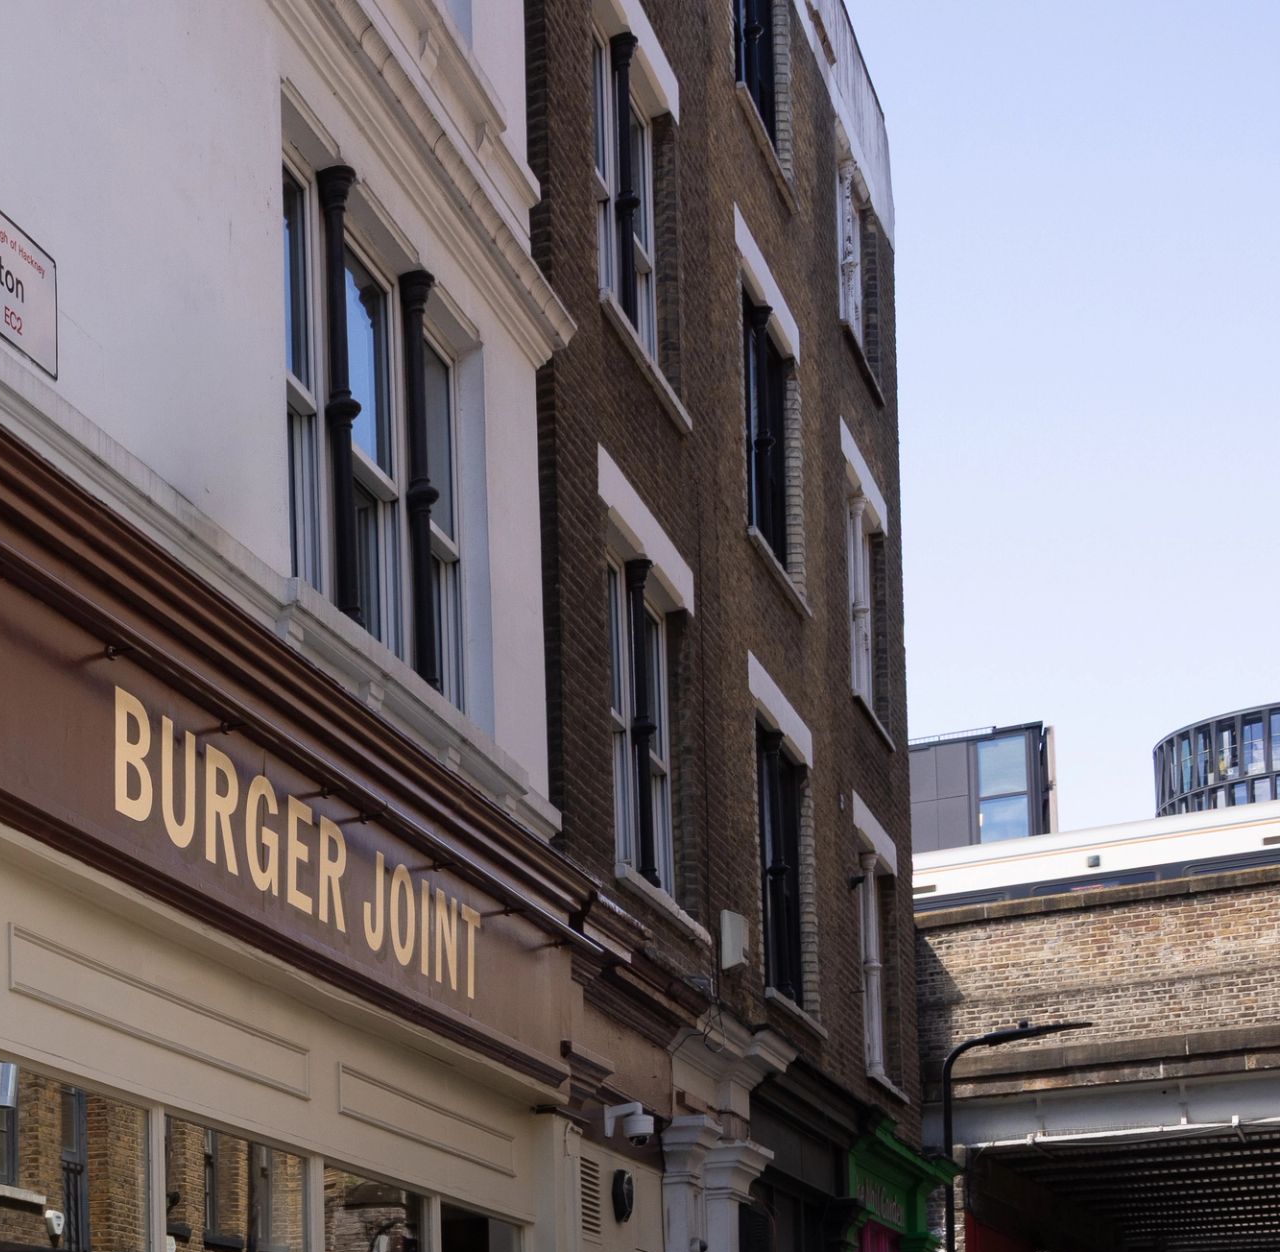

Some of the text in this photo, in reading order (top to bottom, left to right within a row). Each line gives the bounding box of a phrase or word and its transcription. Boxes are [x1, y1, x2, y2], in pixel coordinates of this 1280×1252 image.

[10, 239, 18, 252] of
[18, 243, 46, 280] Hackney
[4, 306, 24, 336] EC2
[114, 686, 481, 1000] BURGER JOINT
